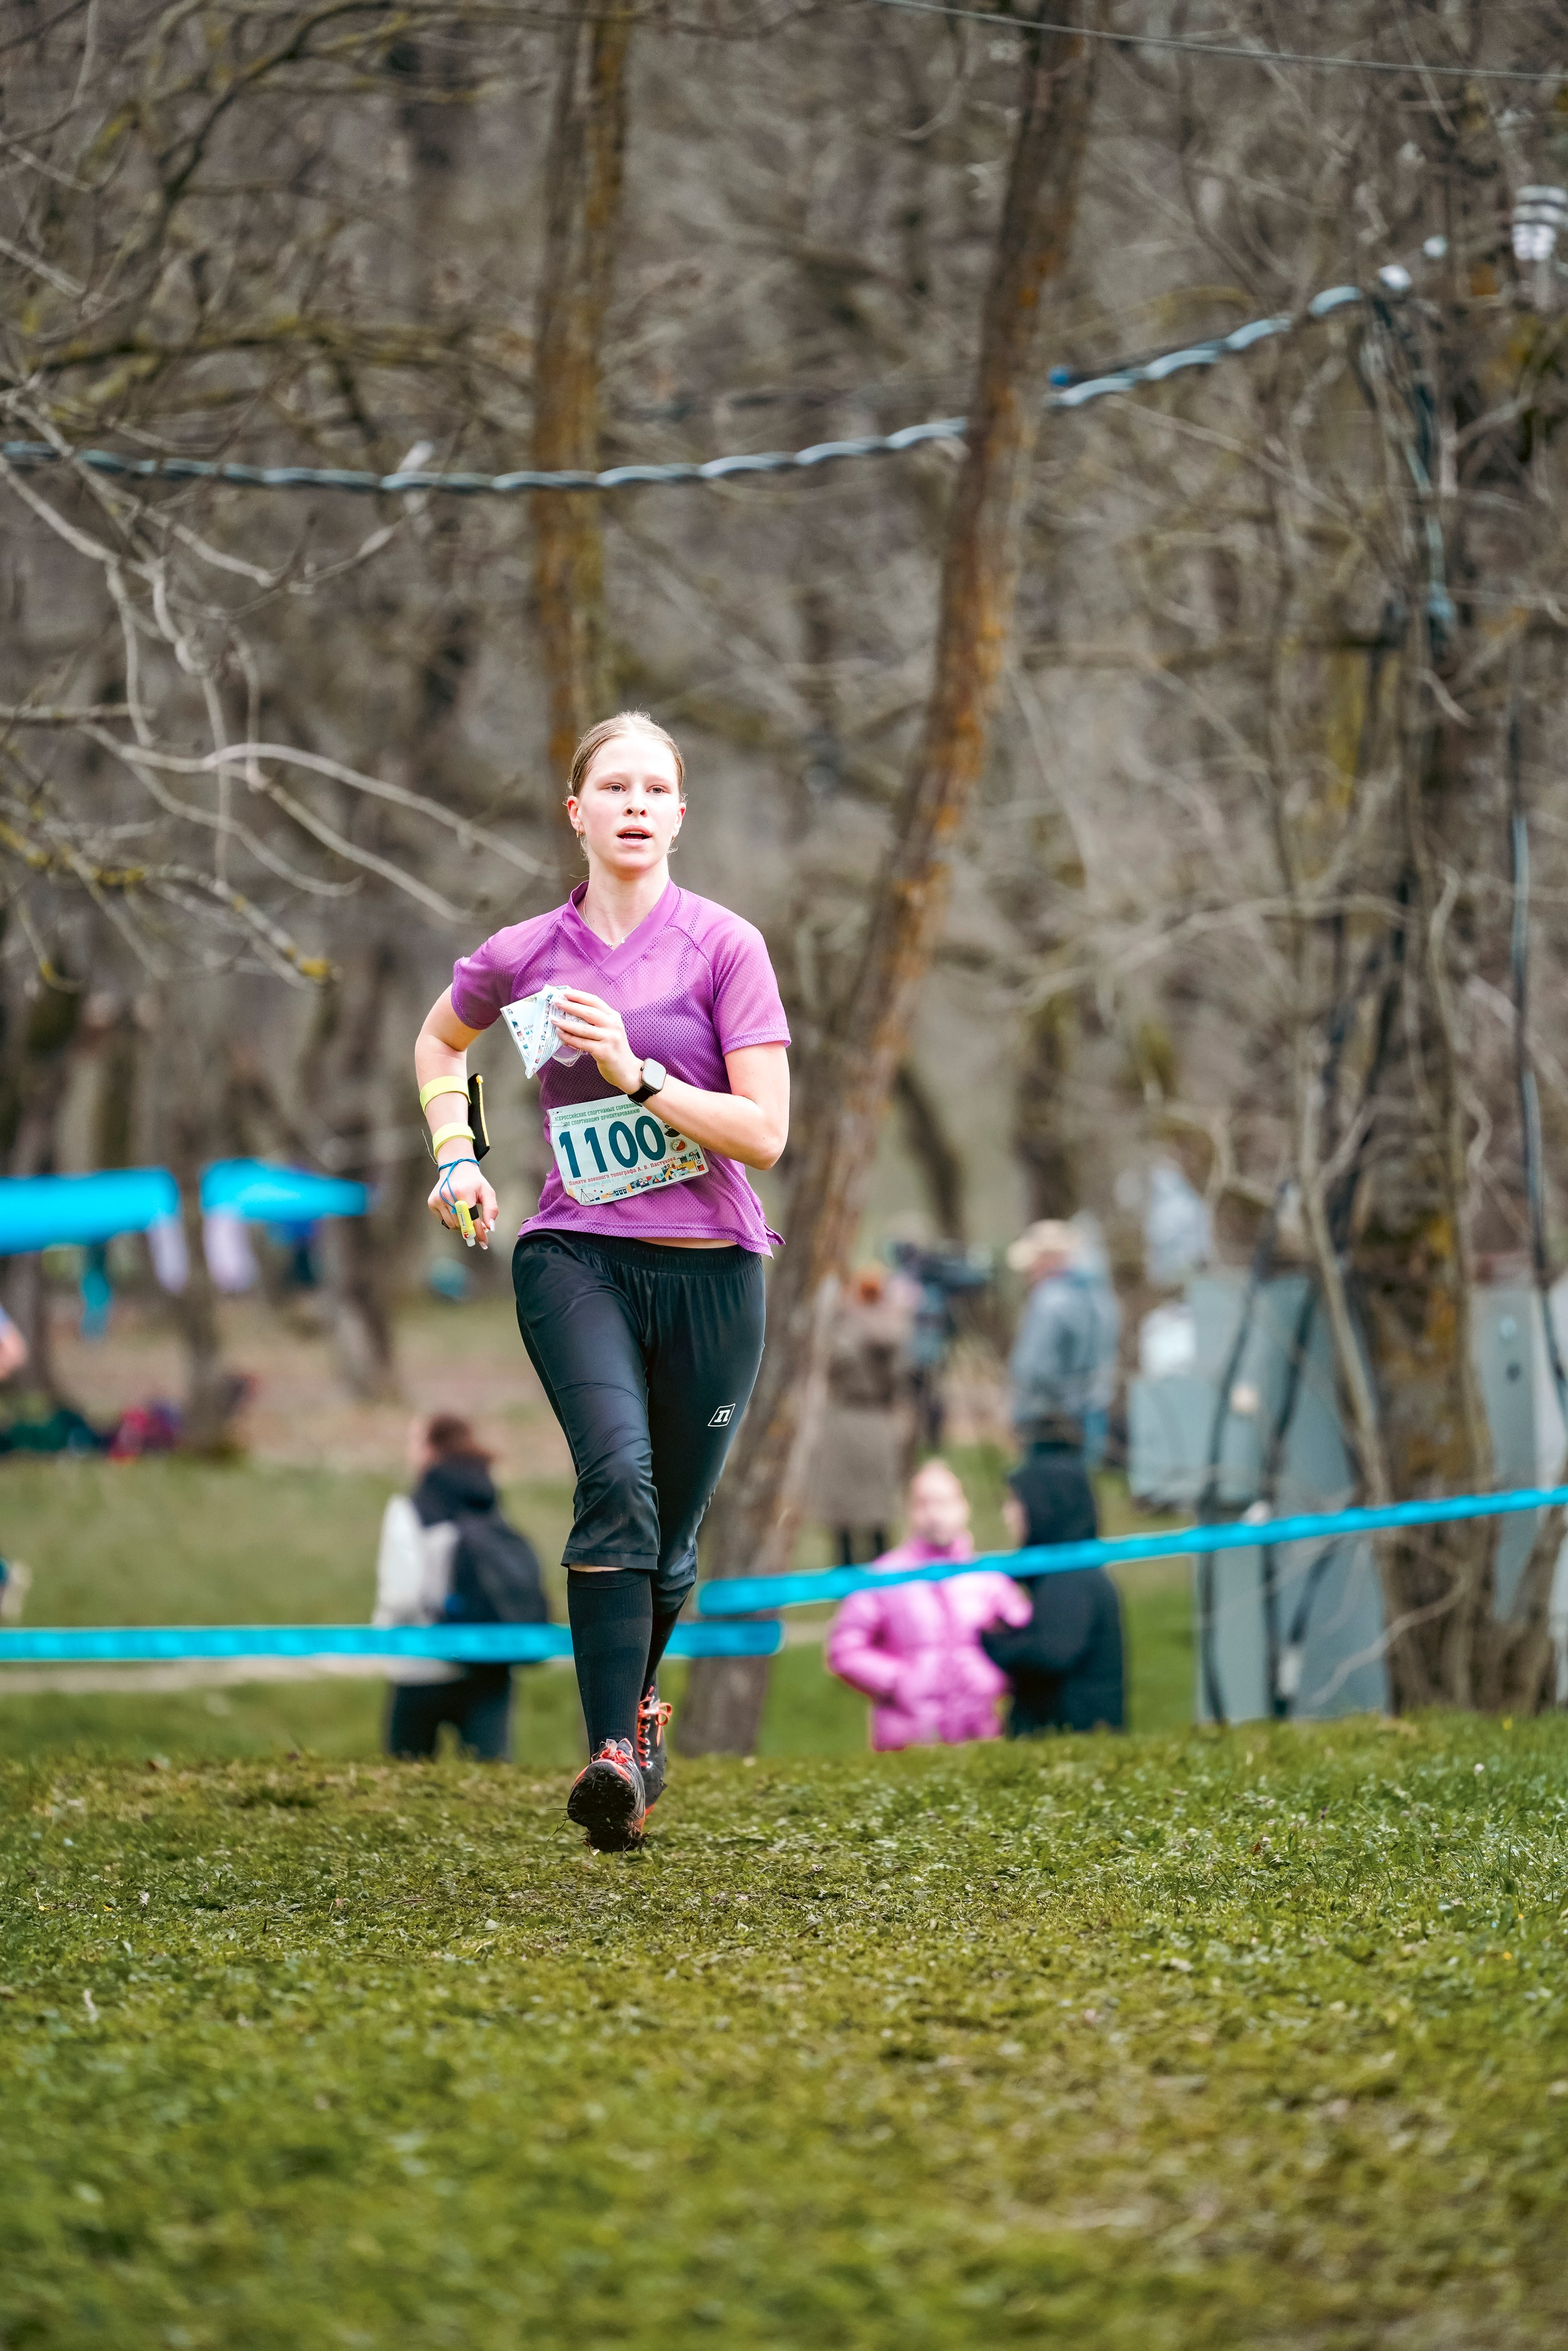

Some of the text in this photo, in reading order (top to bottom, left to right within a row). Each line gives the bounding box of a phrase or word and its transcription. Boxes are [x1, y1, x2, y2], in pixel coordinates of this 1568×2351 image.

[555, 1112, 587, 1122] ВСЕРОССИЙСКИЕ
[587, 1106, 615, 1115] СПОРТИВНЫЕ
[571, 1117, 600, 1125] СПОРТИВНОМУ
[601, 1108, 640, 1120] ОРИЕНТИРОВАНИЮ
[559, 1115, 666, 1179] 1100
[611, 1168, 636, 1178] топографа
[650, 1157, 676, 1168] Пастухова
